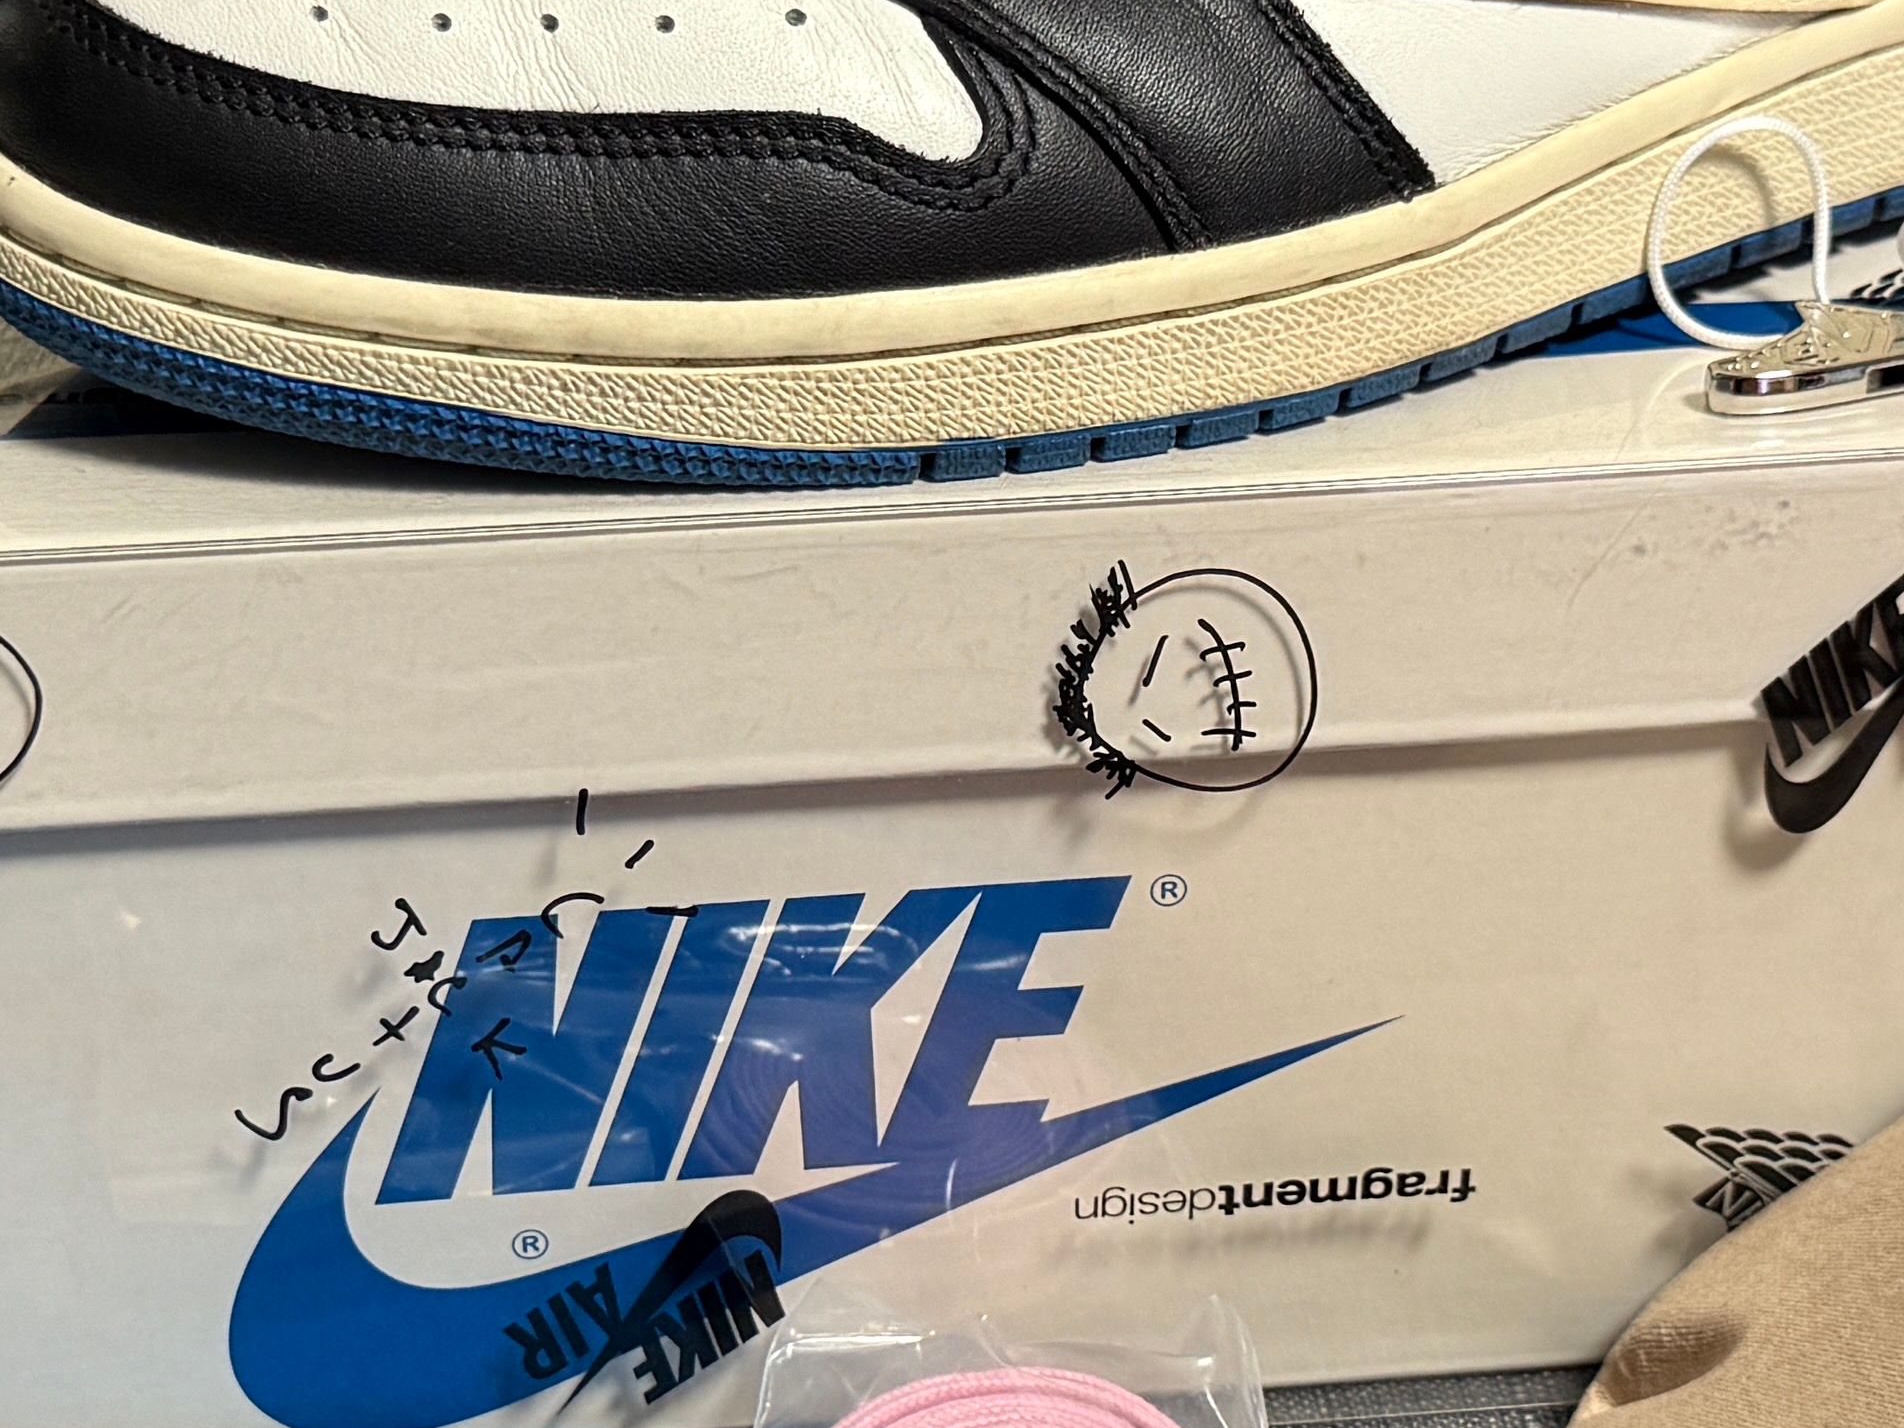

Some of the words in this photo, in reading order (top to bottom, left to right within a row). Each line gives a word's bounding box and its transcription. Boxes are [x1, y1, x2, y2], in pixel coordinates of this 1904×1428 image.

[375, 875, 1132, 1204] NIKE
[1073, 1167, 1477, 1225] fragmentdesign
[503, 1262, 623, 1381] AIR
[626, 1249, 786, 1405] NIKE
